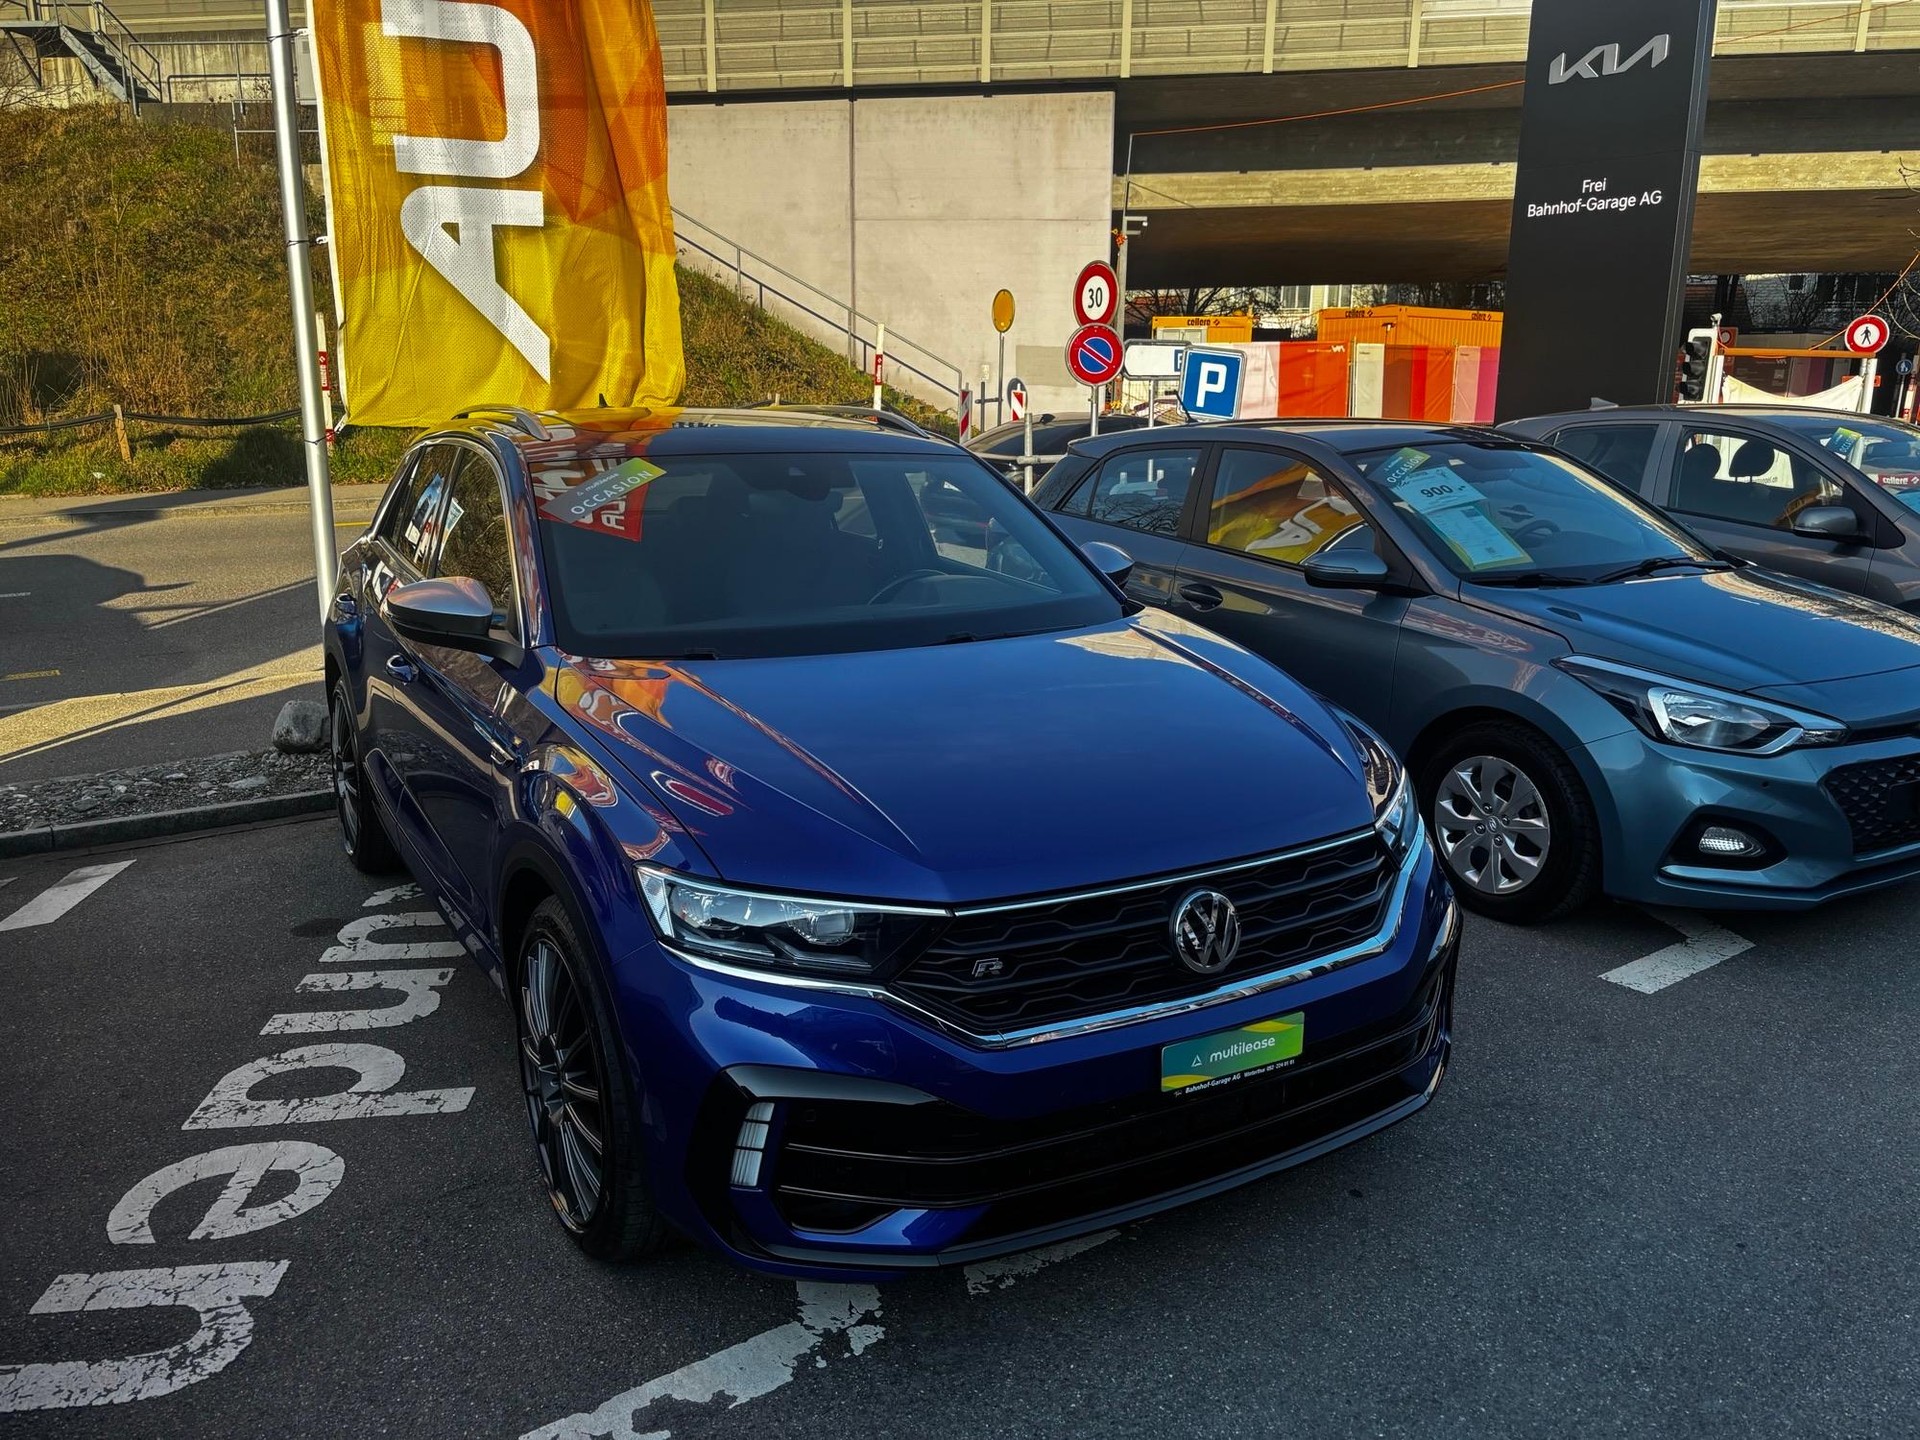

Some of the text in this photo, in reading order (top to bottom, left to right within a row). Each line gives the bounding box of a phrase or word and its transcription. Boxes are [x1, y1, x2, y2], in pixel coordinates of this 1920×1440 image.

[1581, 177, 1607, 194] Frei
[1527, 190, 1662, 218] Bahnhof-Garage AG
[1087, 286, 1103, 309] 30
[1195, 361, 1228, 408] P
[1386, 454, 1425, 484] OCCASION
[570, 470, 654, 515] OCCASION
[1209, 1036, 1276, 1063] multilease
[1185, 1076, 1231, 1094] Bahnhof-Garage
[1231, 1072, 1242, 1081] AG
[0, 883, 477, 1412] unden
